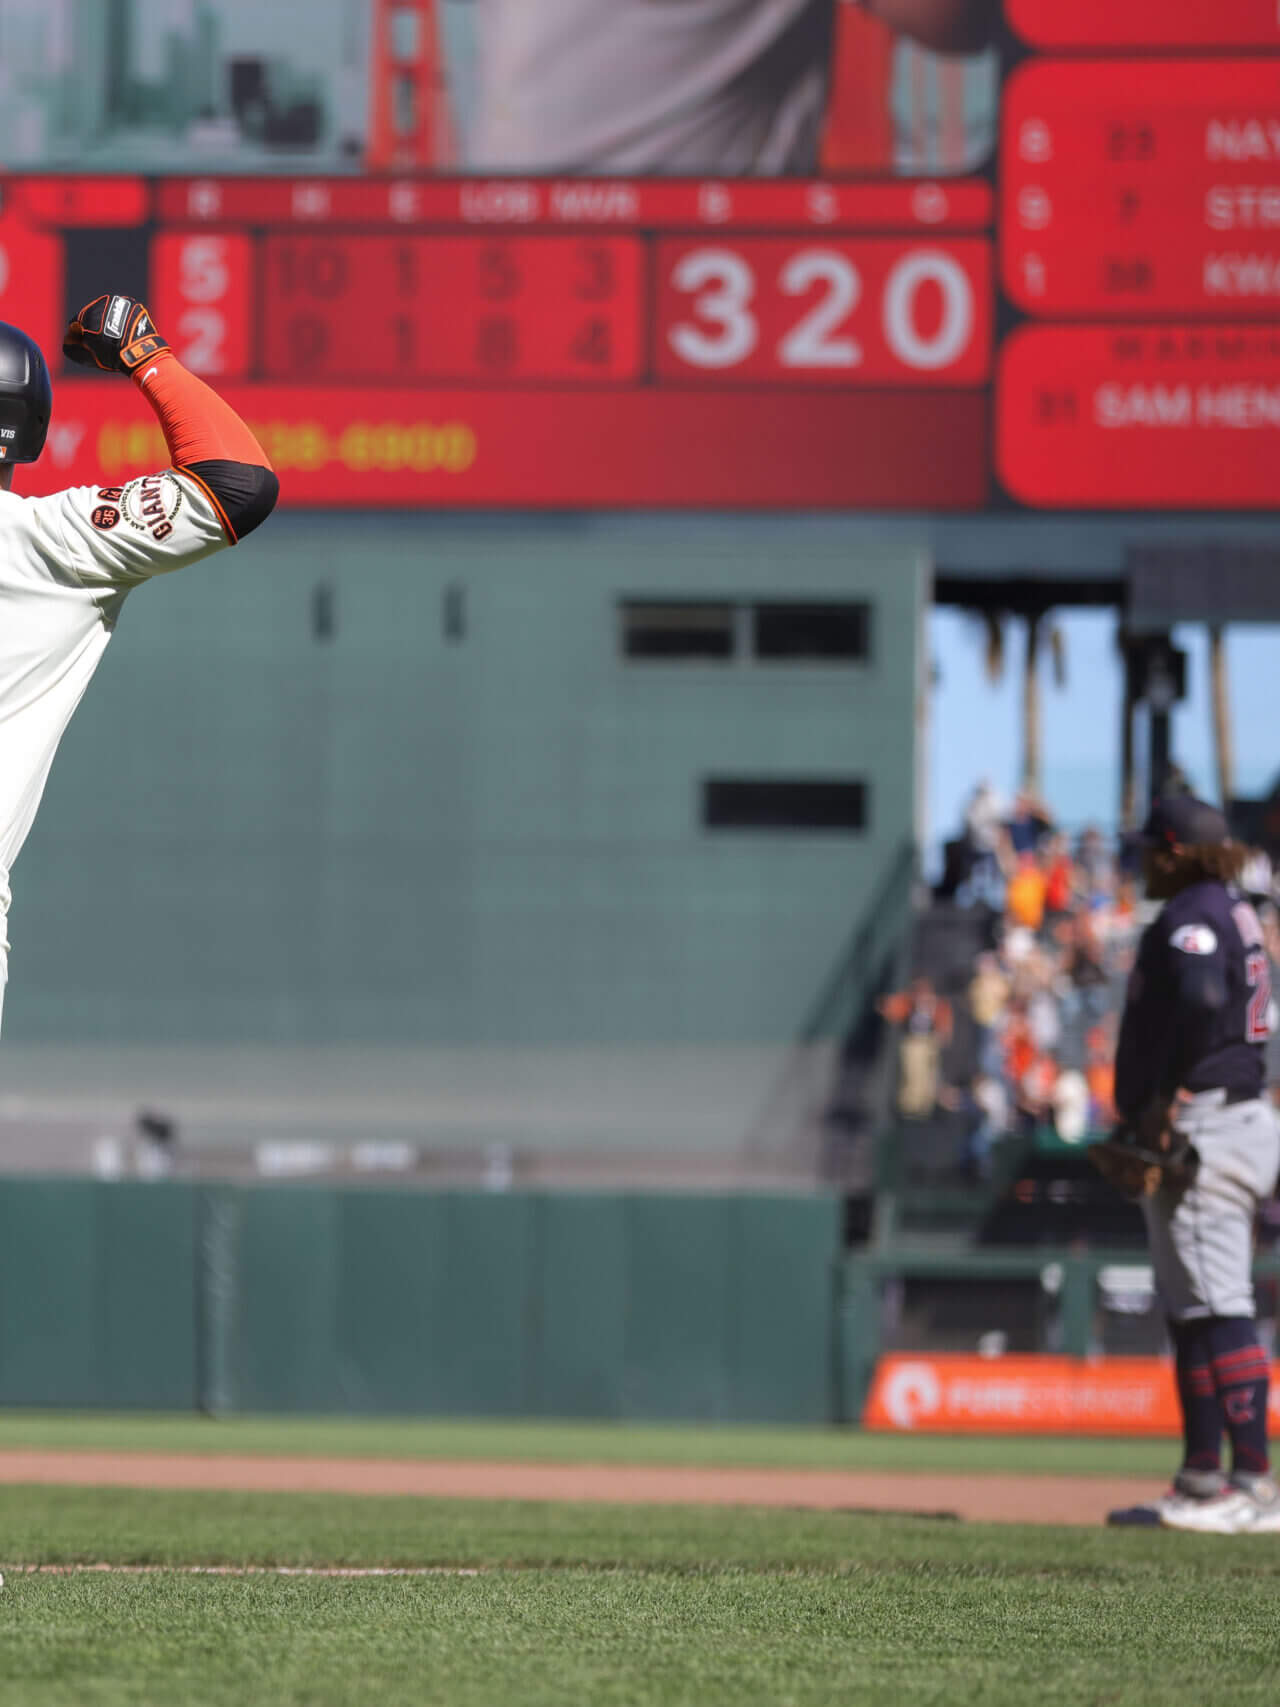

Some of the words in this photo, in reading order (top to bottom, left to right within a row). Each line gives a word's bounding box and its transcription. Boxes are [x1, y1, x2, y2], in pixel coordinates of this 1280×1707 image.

[180, 236, 228, 303] 5
[670, 249, 759, 369] 3
[779, 250, 862, 368] 2
[882, 250, 974, 370] 0
[178, 316, 226, 375] 2
[1096, 384, 1192, 428] SAM
[102, 509, 117, 526] 36
